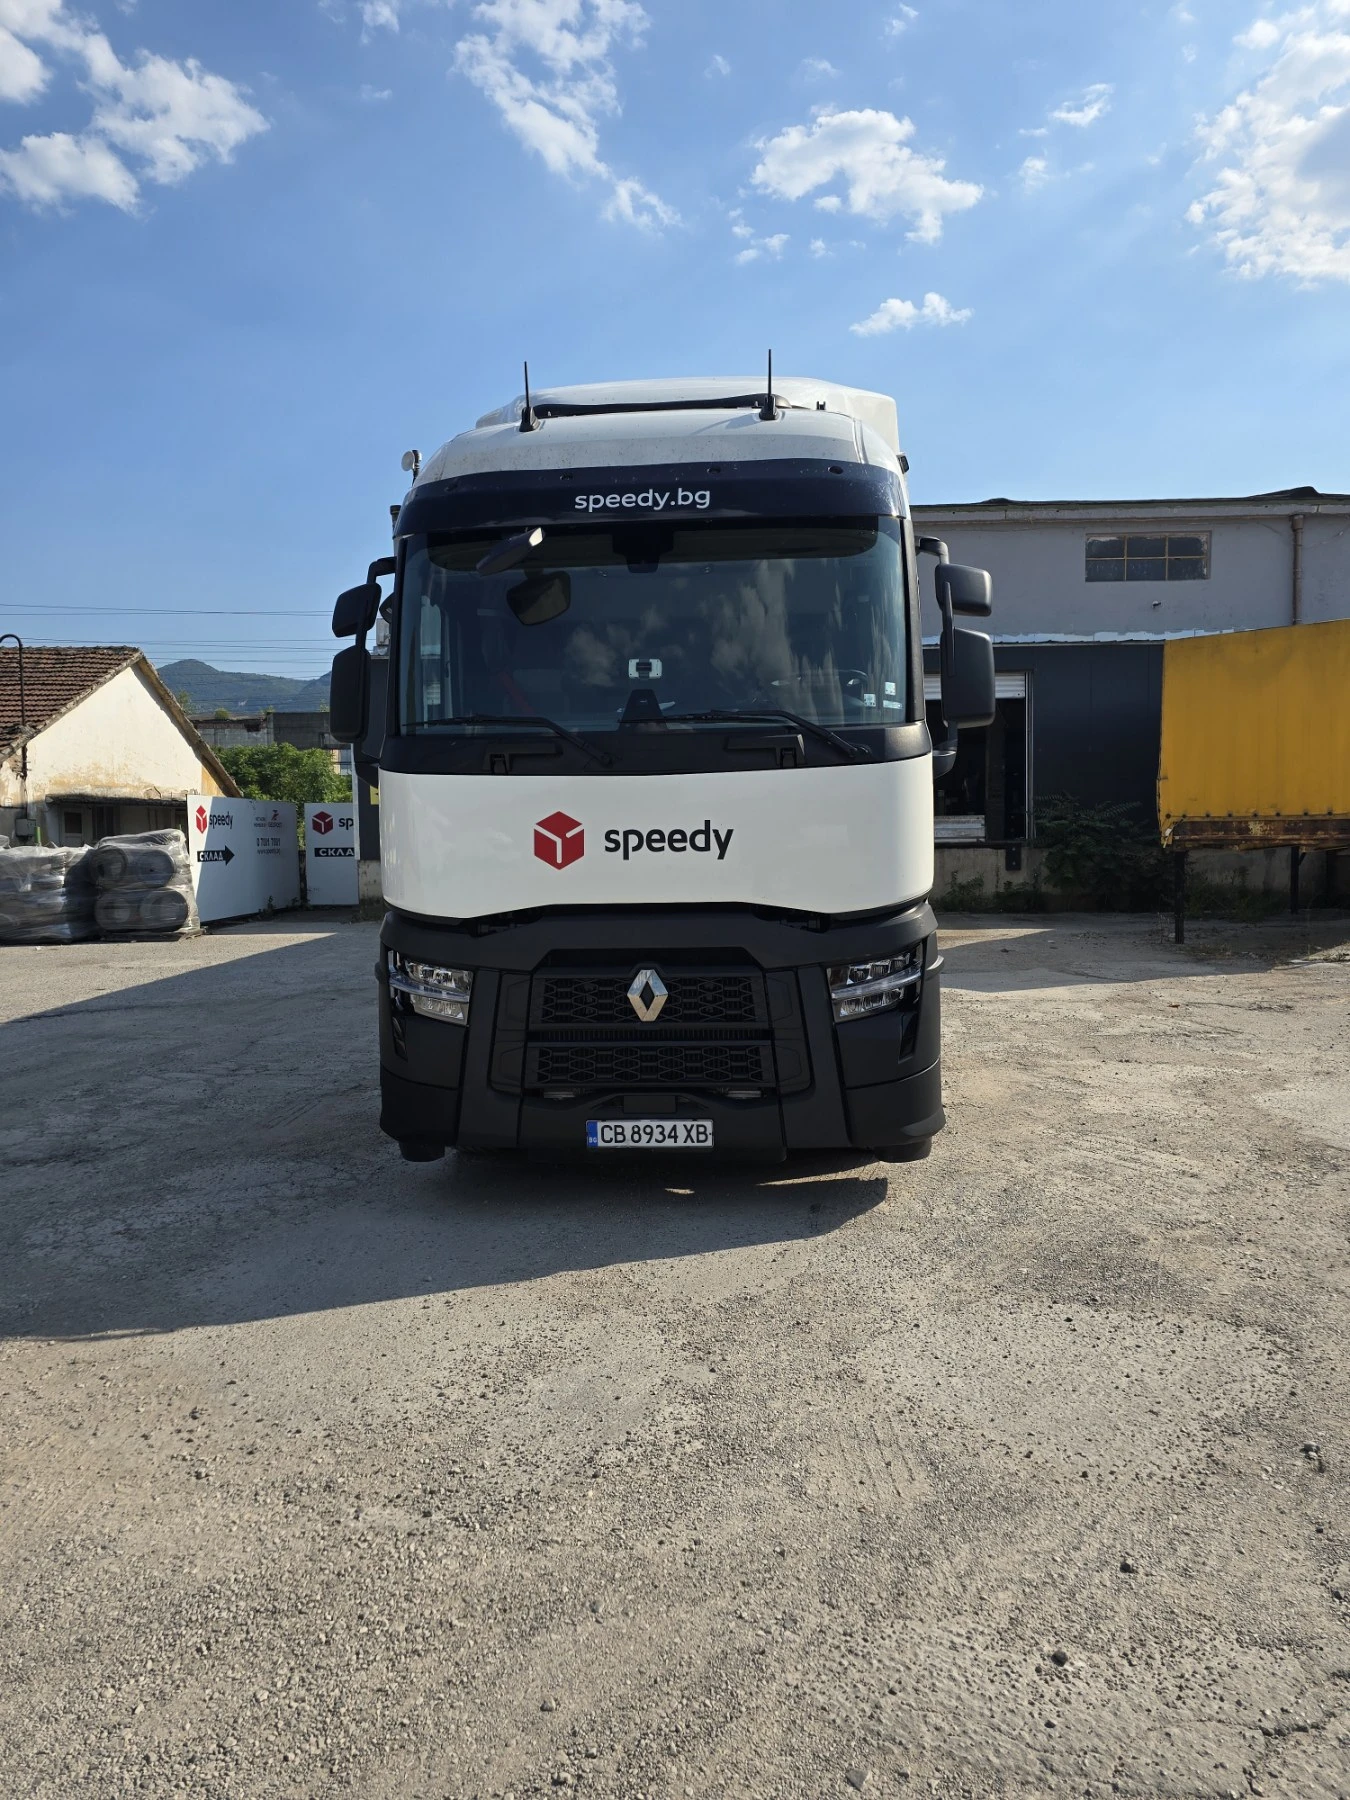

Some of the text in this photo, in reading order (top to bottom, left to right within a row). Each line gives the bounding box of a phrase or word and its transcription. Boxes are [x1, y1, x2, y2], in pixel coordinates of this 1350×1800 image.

[574, 487, 711, 513] speedy.bg
[209, 811, 234, 830] speedy
[604, 819, 734, 861] speedy
[199, 851, 224, 861] СКЛАД
[319, 848, 355, 856] СКЛА
[600, 1123, 709, 1144] CB 8934 XB
